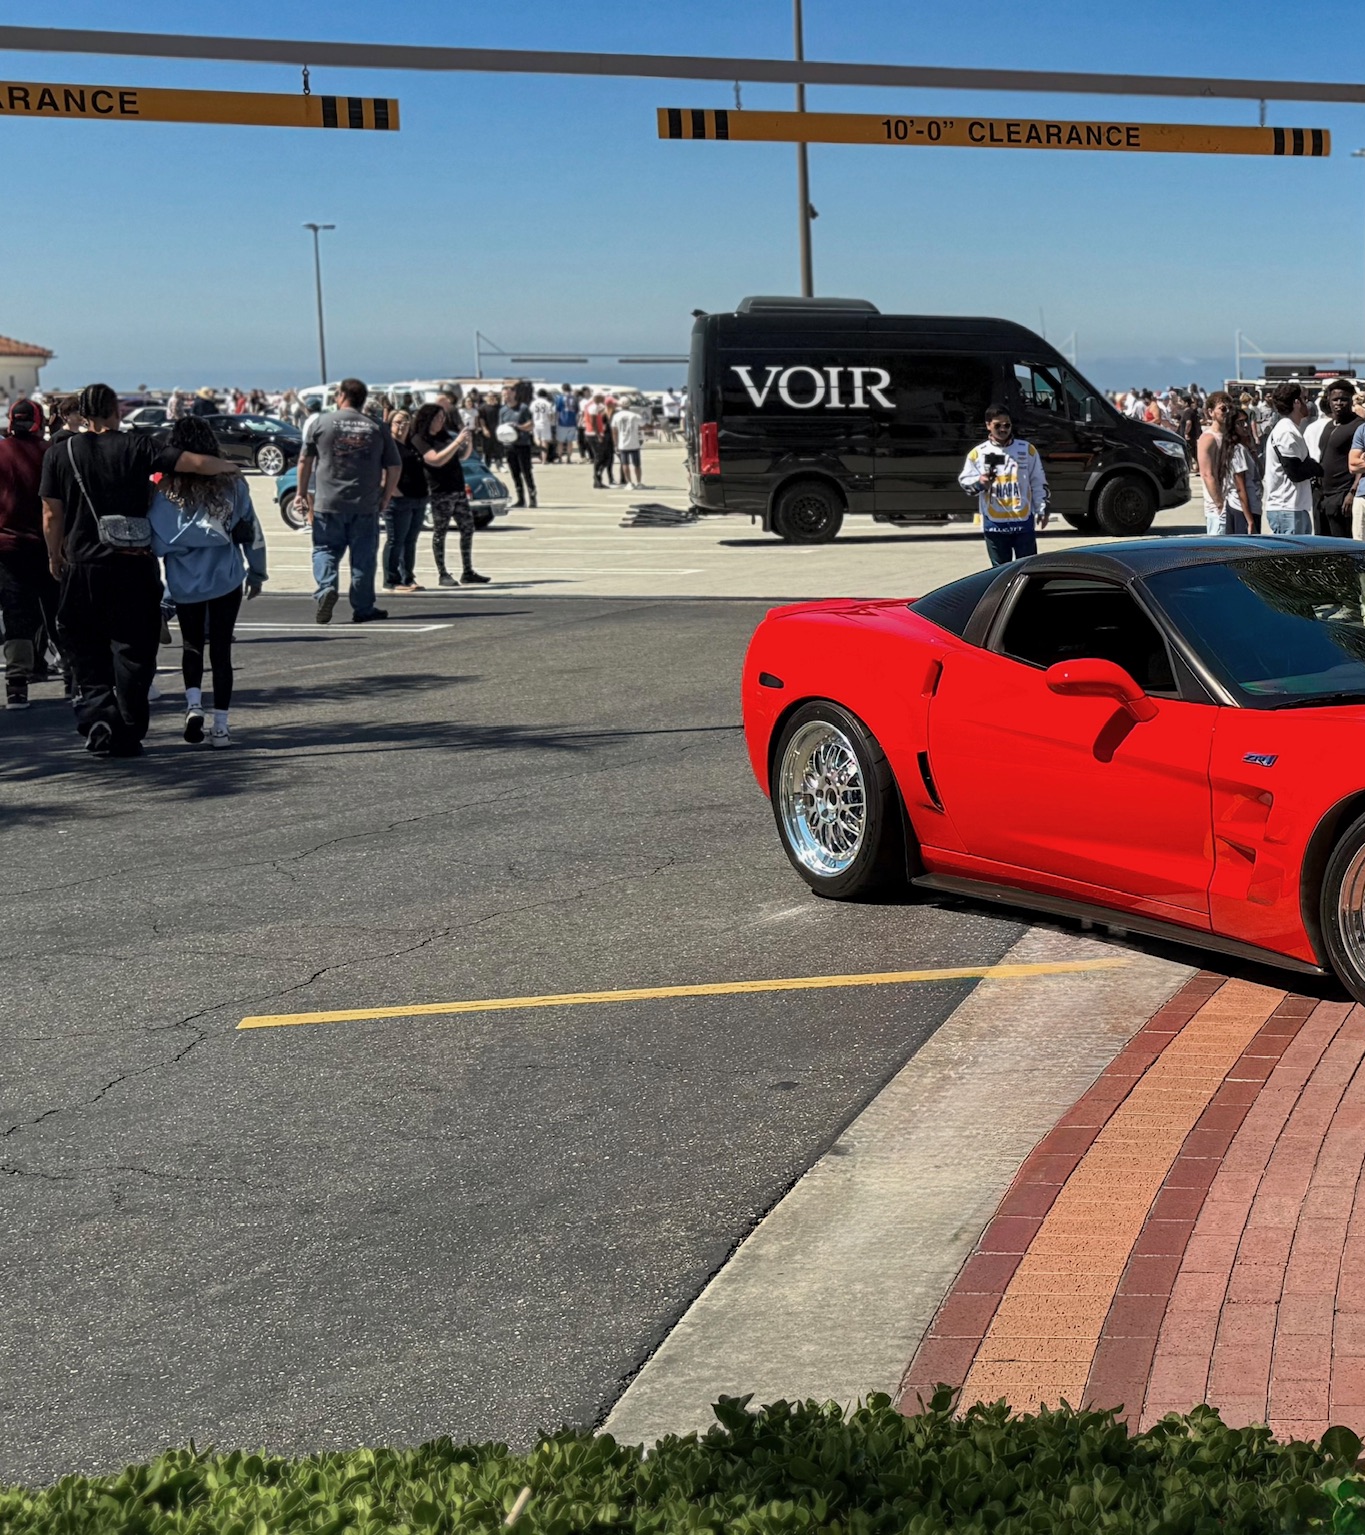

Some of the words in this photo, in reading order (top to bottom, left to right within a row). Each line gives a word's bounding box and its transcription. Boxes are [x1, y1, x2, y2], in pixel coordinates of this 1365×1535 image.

[0, 86, 139, 115] RANCE
[882, 119, 954, 141] 10'-0"
[968, 121, 1141, 147] CLEARANCE
[730, 366, 896, 409] VOIR
